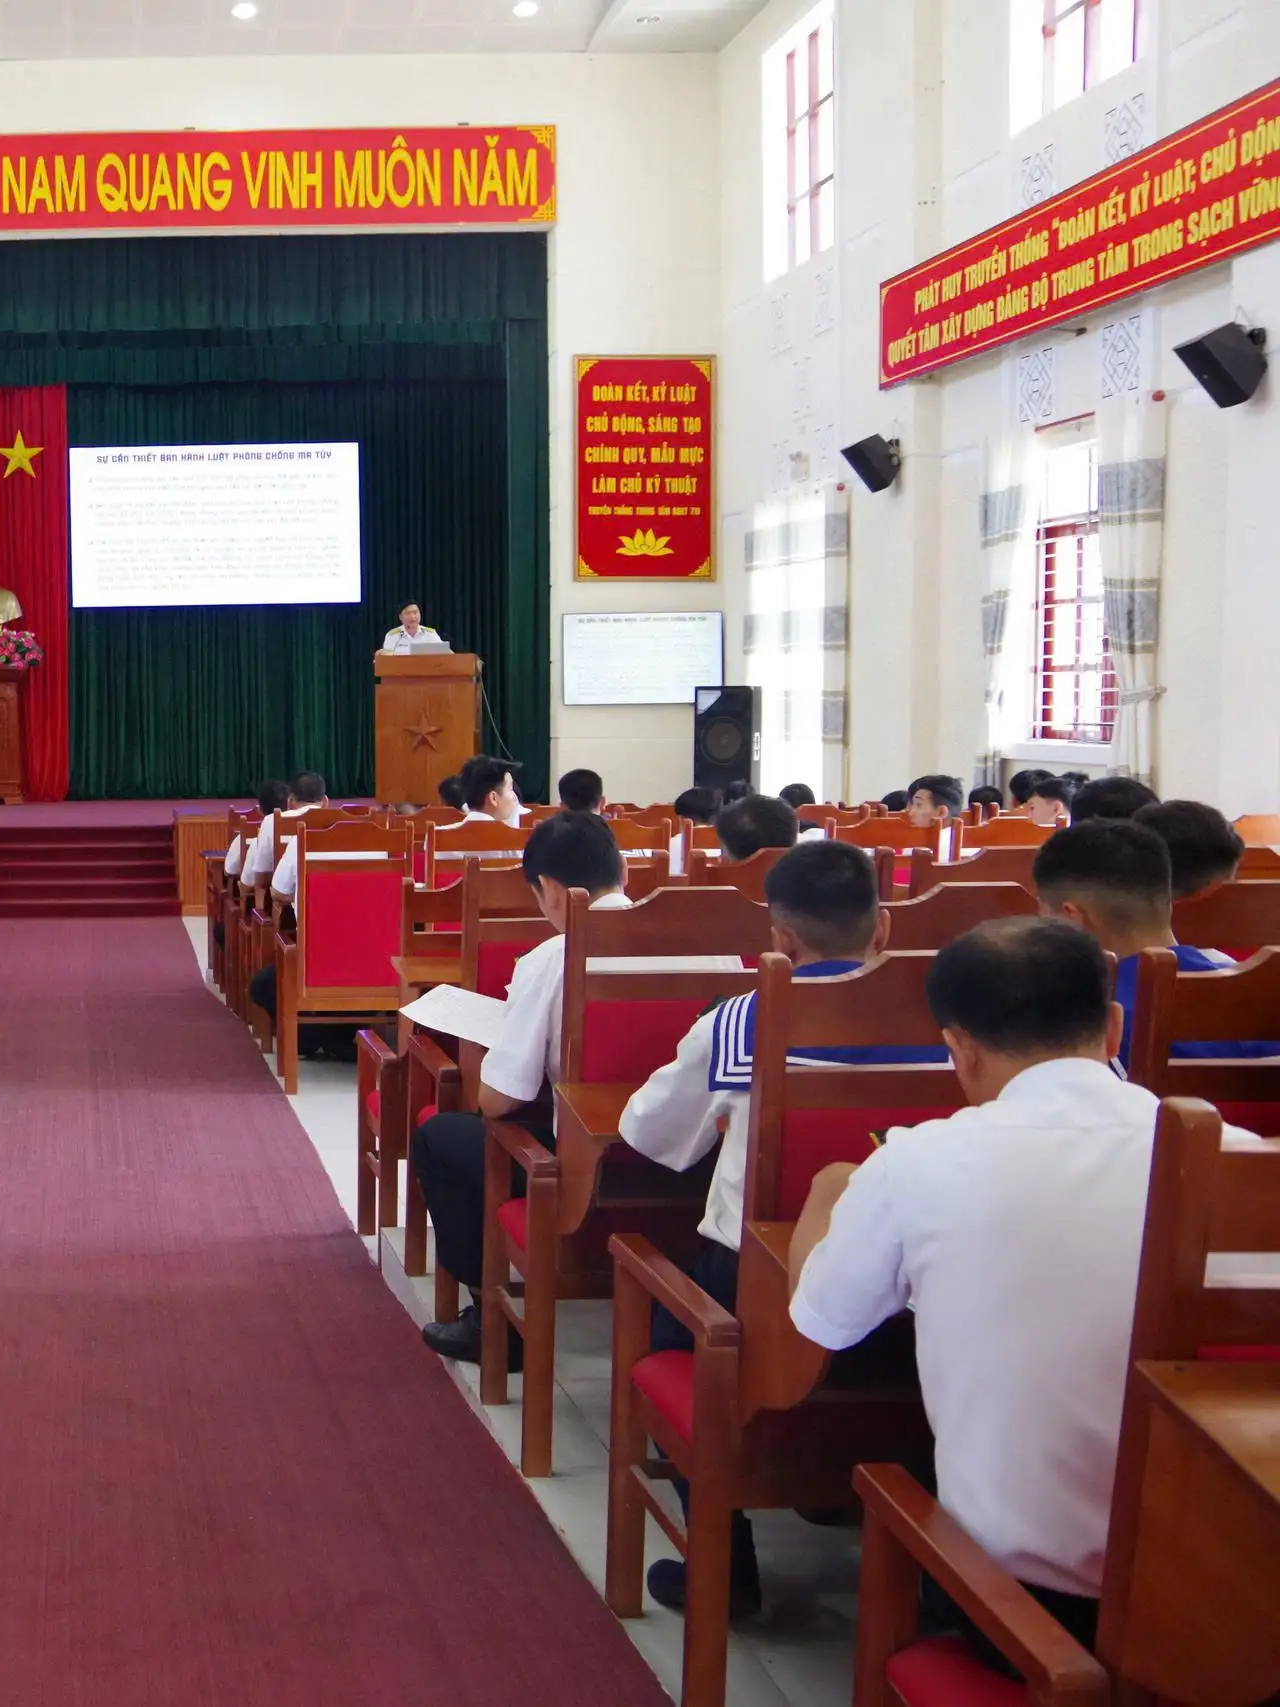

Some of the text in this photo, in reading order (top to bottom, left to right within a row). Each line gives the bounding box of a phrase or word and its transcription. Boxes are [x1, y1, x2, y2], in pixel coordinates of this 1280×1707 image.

[2, 153, 86, 215] NAM
[96, 152, 232, 213] QUANG
[241, 150, 323, 209] VINH
[334, 135, 441, 209] MUÔN
[452, 135, 538, 206] NĂM
[914, 279, 940, 316] PHÁT
[941, 271, 963, 304] HUY
[964, 244, 1007, 292] TRUYỀN
[1009, 227, 1049, 272] THỐNG
[1098, 185, 1127, 232] KẾT,
[1130, 170, 1151, 217] KỶ
[1200, 127, 1236, 184] CHỦ
[888, 326, 917, 368] QUYẾT
[918, 322, 940, 353] TÂM
[941, 311, 962, 345] XÂY
[964, 300, 995, 338] DỰNG
[996, 283, 1029, 323] ĐẢNG
[1031, 271, 1049, 312] BỘ
[1051, 257, 1095, 301] TRUNG
[1097, 242, 1129, 282] TÂM
[1131, 219, 1184, 268] TRONG
[1186, 195, 1234, 247] SẠCH
